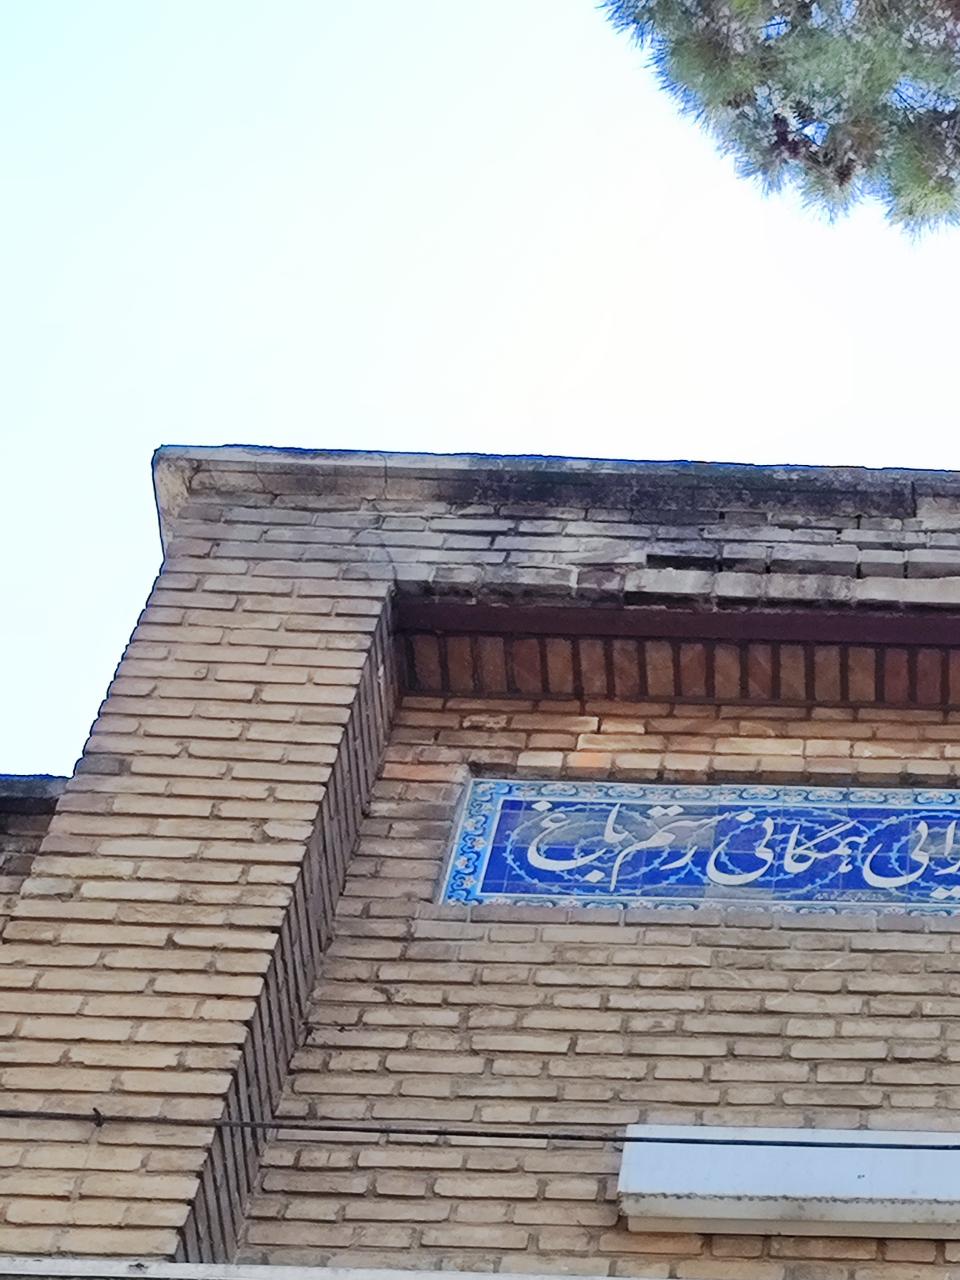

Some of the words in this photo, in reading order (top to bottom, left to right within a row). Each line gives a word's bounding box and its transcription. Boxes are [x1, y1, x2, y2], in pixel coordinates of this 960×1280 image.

[526, 799, 628, 884] باغ
[609, 803, 731, 893] رستم
[706, 811, 869, 886] همگانی
